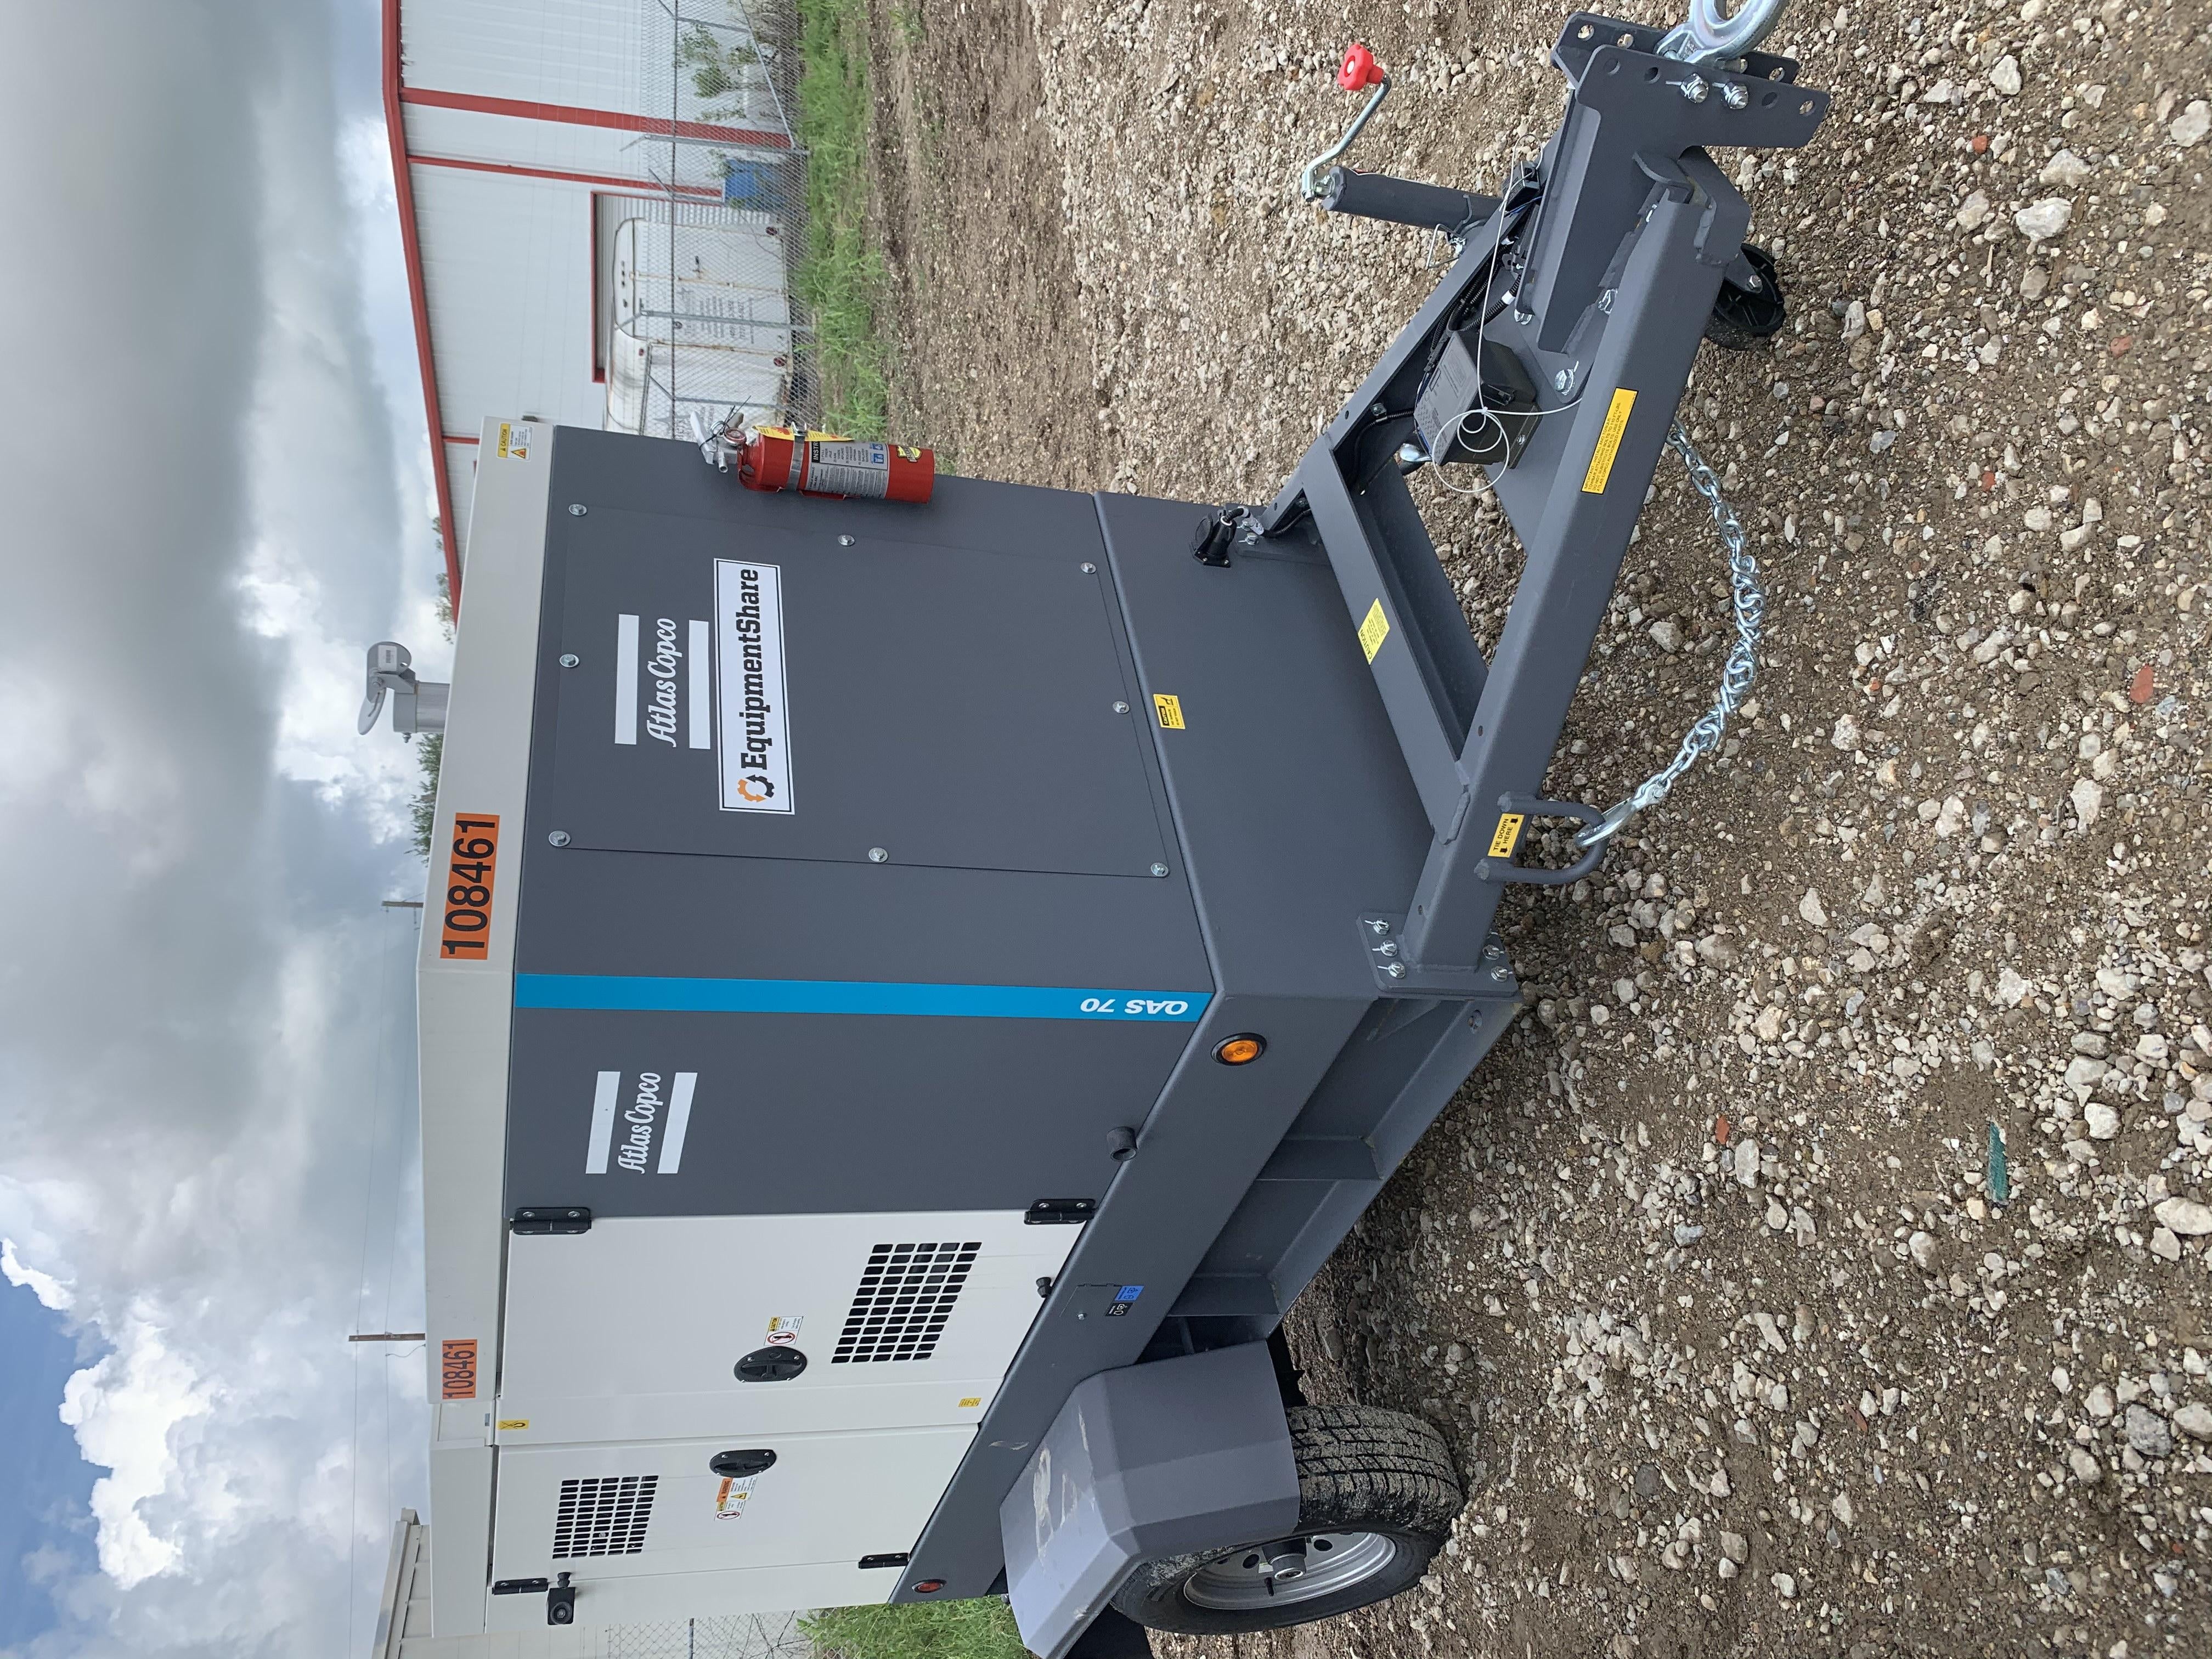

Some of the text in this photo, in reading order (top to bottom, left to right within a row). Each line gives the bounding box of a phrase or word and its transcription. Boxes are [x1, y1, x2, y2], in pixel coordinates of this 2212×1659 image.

[1596, 478, 1605, 492] ATLAS
[1359, 629, 1373, 659] CAUTION
[735, 569, 772, 770] EquipmentShare
[1497, 819, 1509, 839] DOWN
[1503, 827, 1513, 844] HERE
[442, 819, 496, 955] 108461
[1080, 997, 1189, 1015] QAS 70
[443, 1340, 477, 1399] 108461
